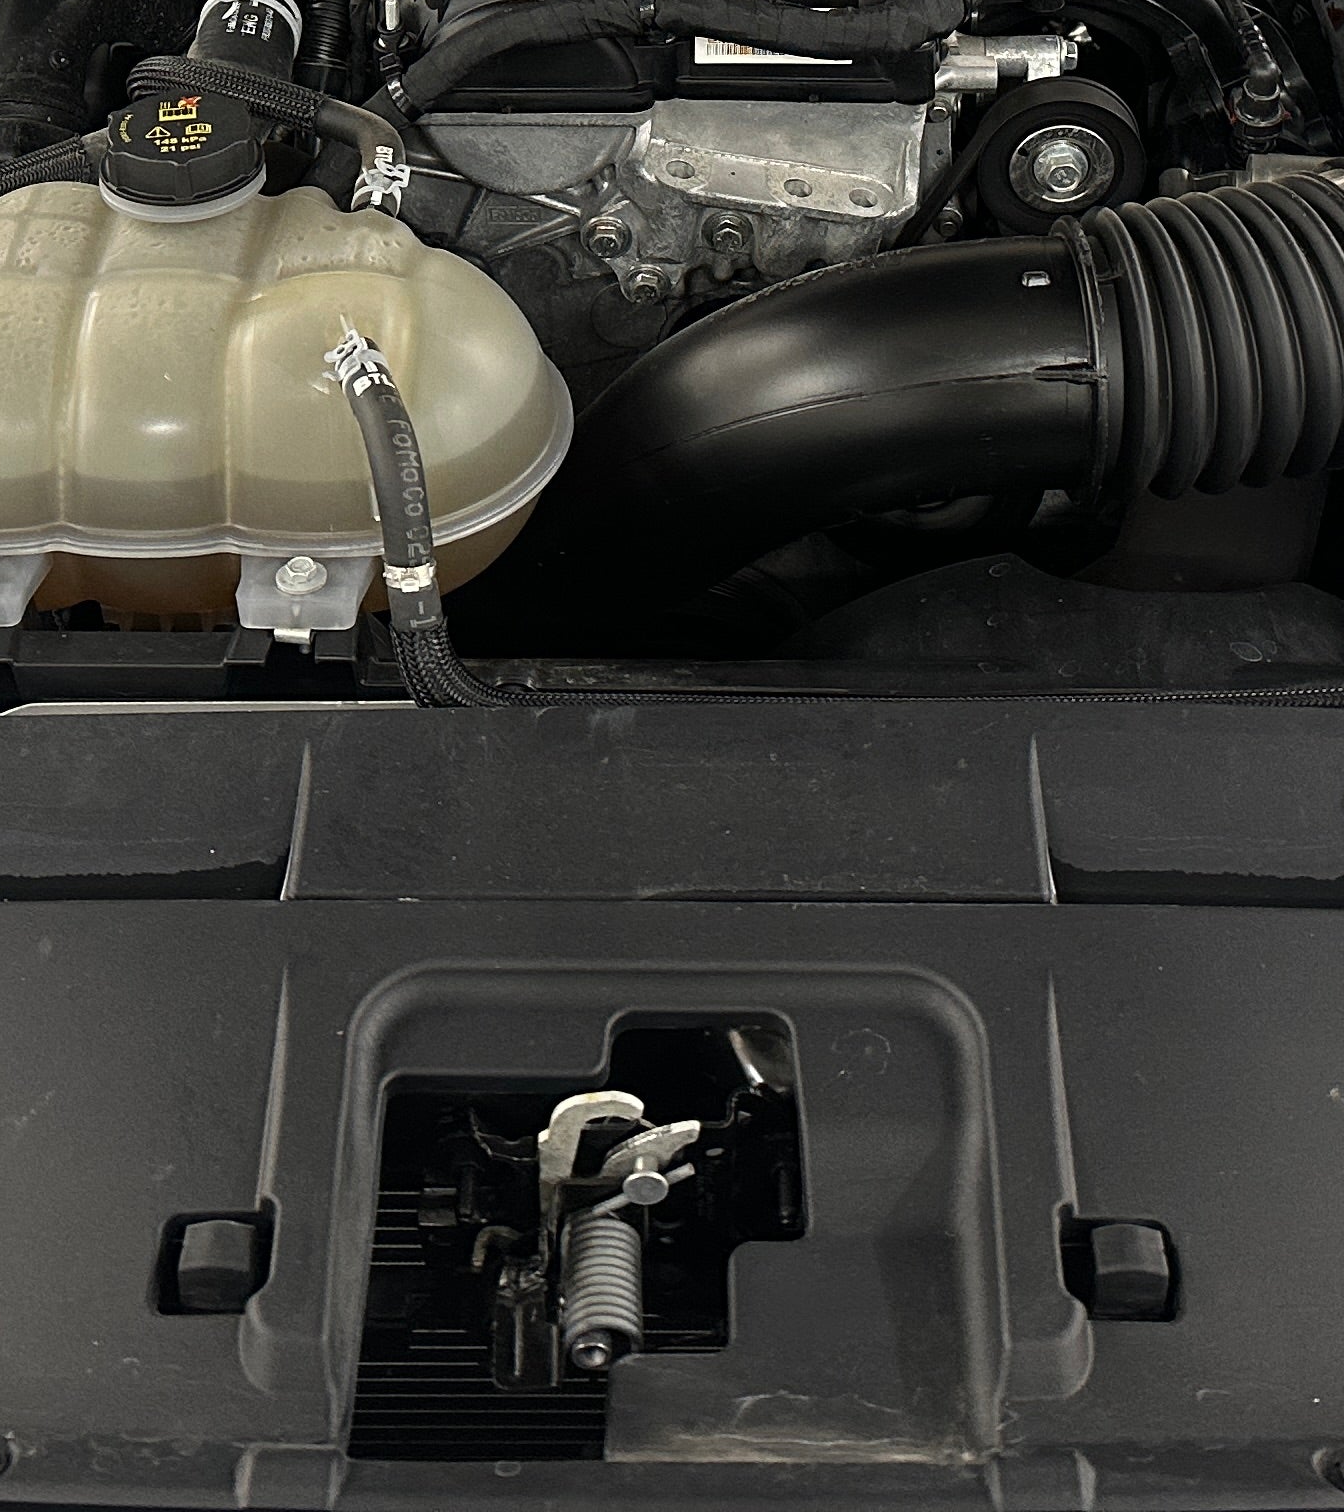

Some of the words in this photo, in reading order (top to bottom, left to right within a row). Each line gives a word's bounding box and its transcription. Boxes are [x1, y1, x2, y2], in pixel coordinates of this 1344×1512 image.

[181, 136, 207, 144] kPa
[180, 143, 201, 152] psi
[387, 419, 425, 517] FoMoCo
